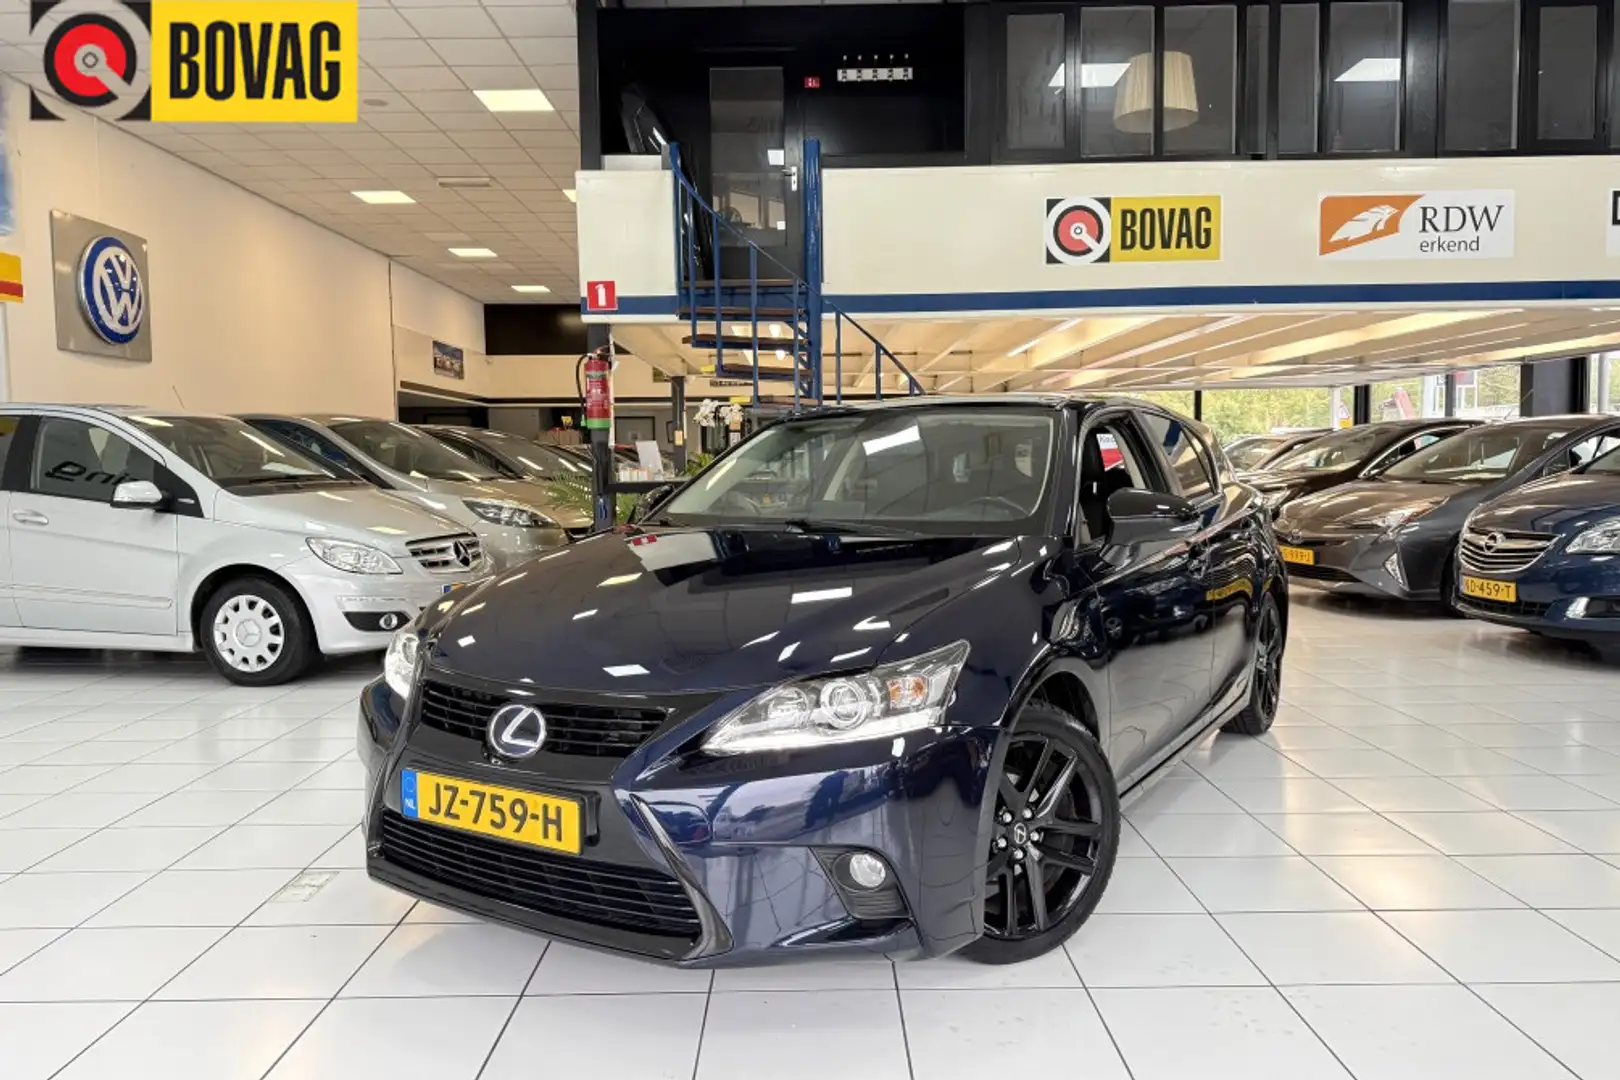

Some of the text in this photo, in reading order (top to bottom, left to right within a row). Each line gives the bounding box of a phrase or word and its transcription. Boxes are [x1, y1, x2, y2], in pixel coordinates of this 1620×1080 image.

[1120, 206, 1212, 251] BOVAG
[1419, 204, 1505, 233] RDW
[1419, 236, 1480, 253] erkend
[428, 783, 563, 842] JZ-759-H
